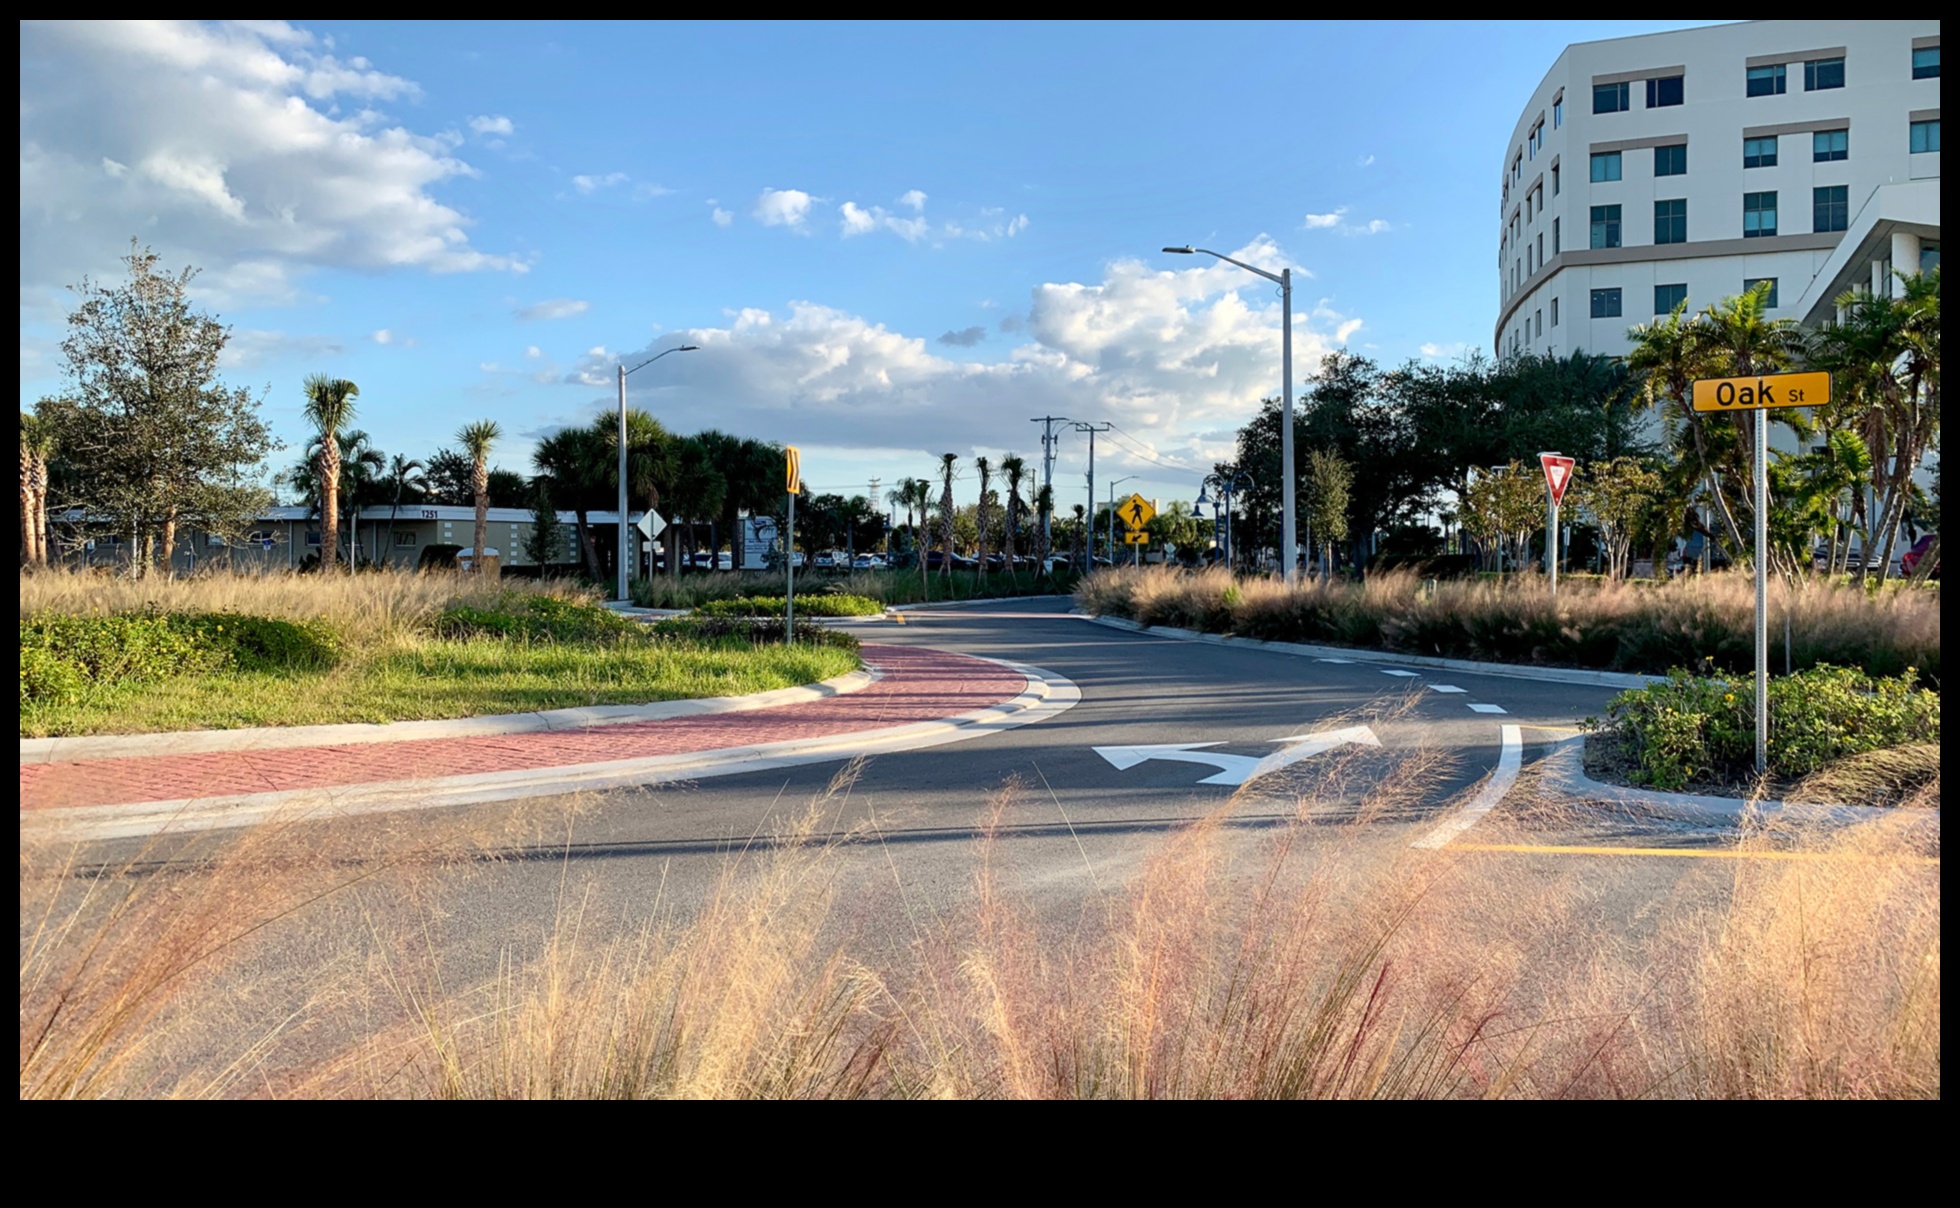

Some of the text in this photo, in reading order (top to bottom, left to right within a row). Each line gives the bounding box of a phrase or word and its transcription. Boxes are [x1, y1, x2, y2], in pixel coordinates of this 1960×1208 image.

[1716, 380, 1805, 406] Oak St
[421, 509, 438, 519] 1251
